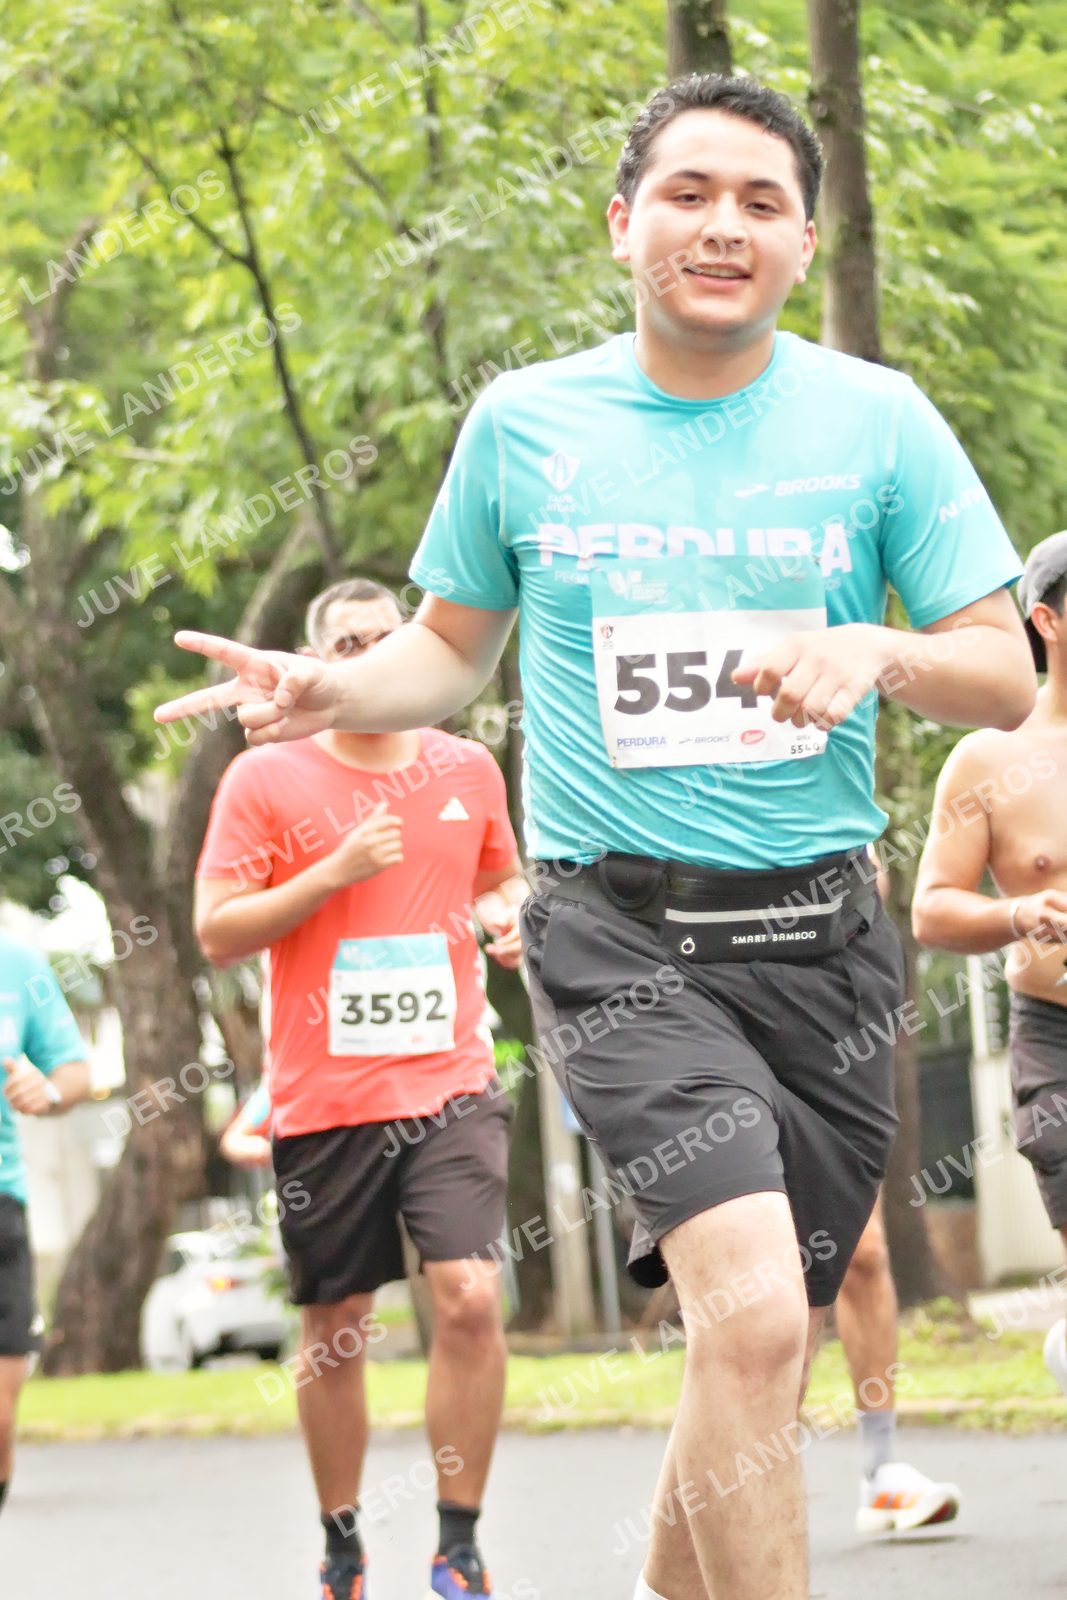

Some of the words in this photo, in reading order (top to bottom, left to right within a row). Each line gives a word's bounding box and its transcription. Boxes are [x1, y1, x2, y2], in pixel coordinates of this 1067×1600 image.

[775, 474, 862, 497] BROOKS
[613, 649, 778, 716] 554
[616, 736, 668, 748] PERDURA
[732, 934, 767, 945] SMART
[772, 929, 817, 943] BAMBOO
[340, 988, 448, 1026] 3592
